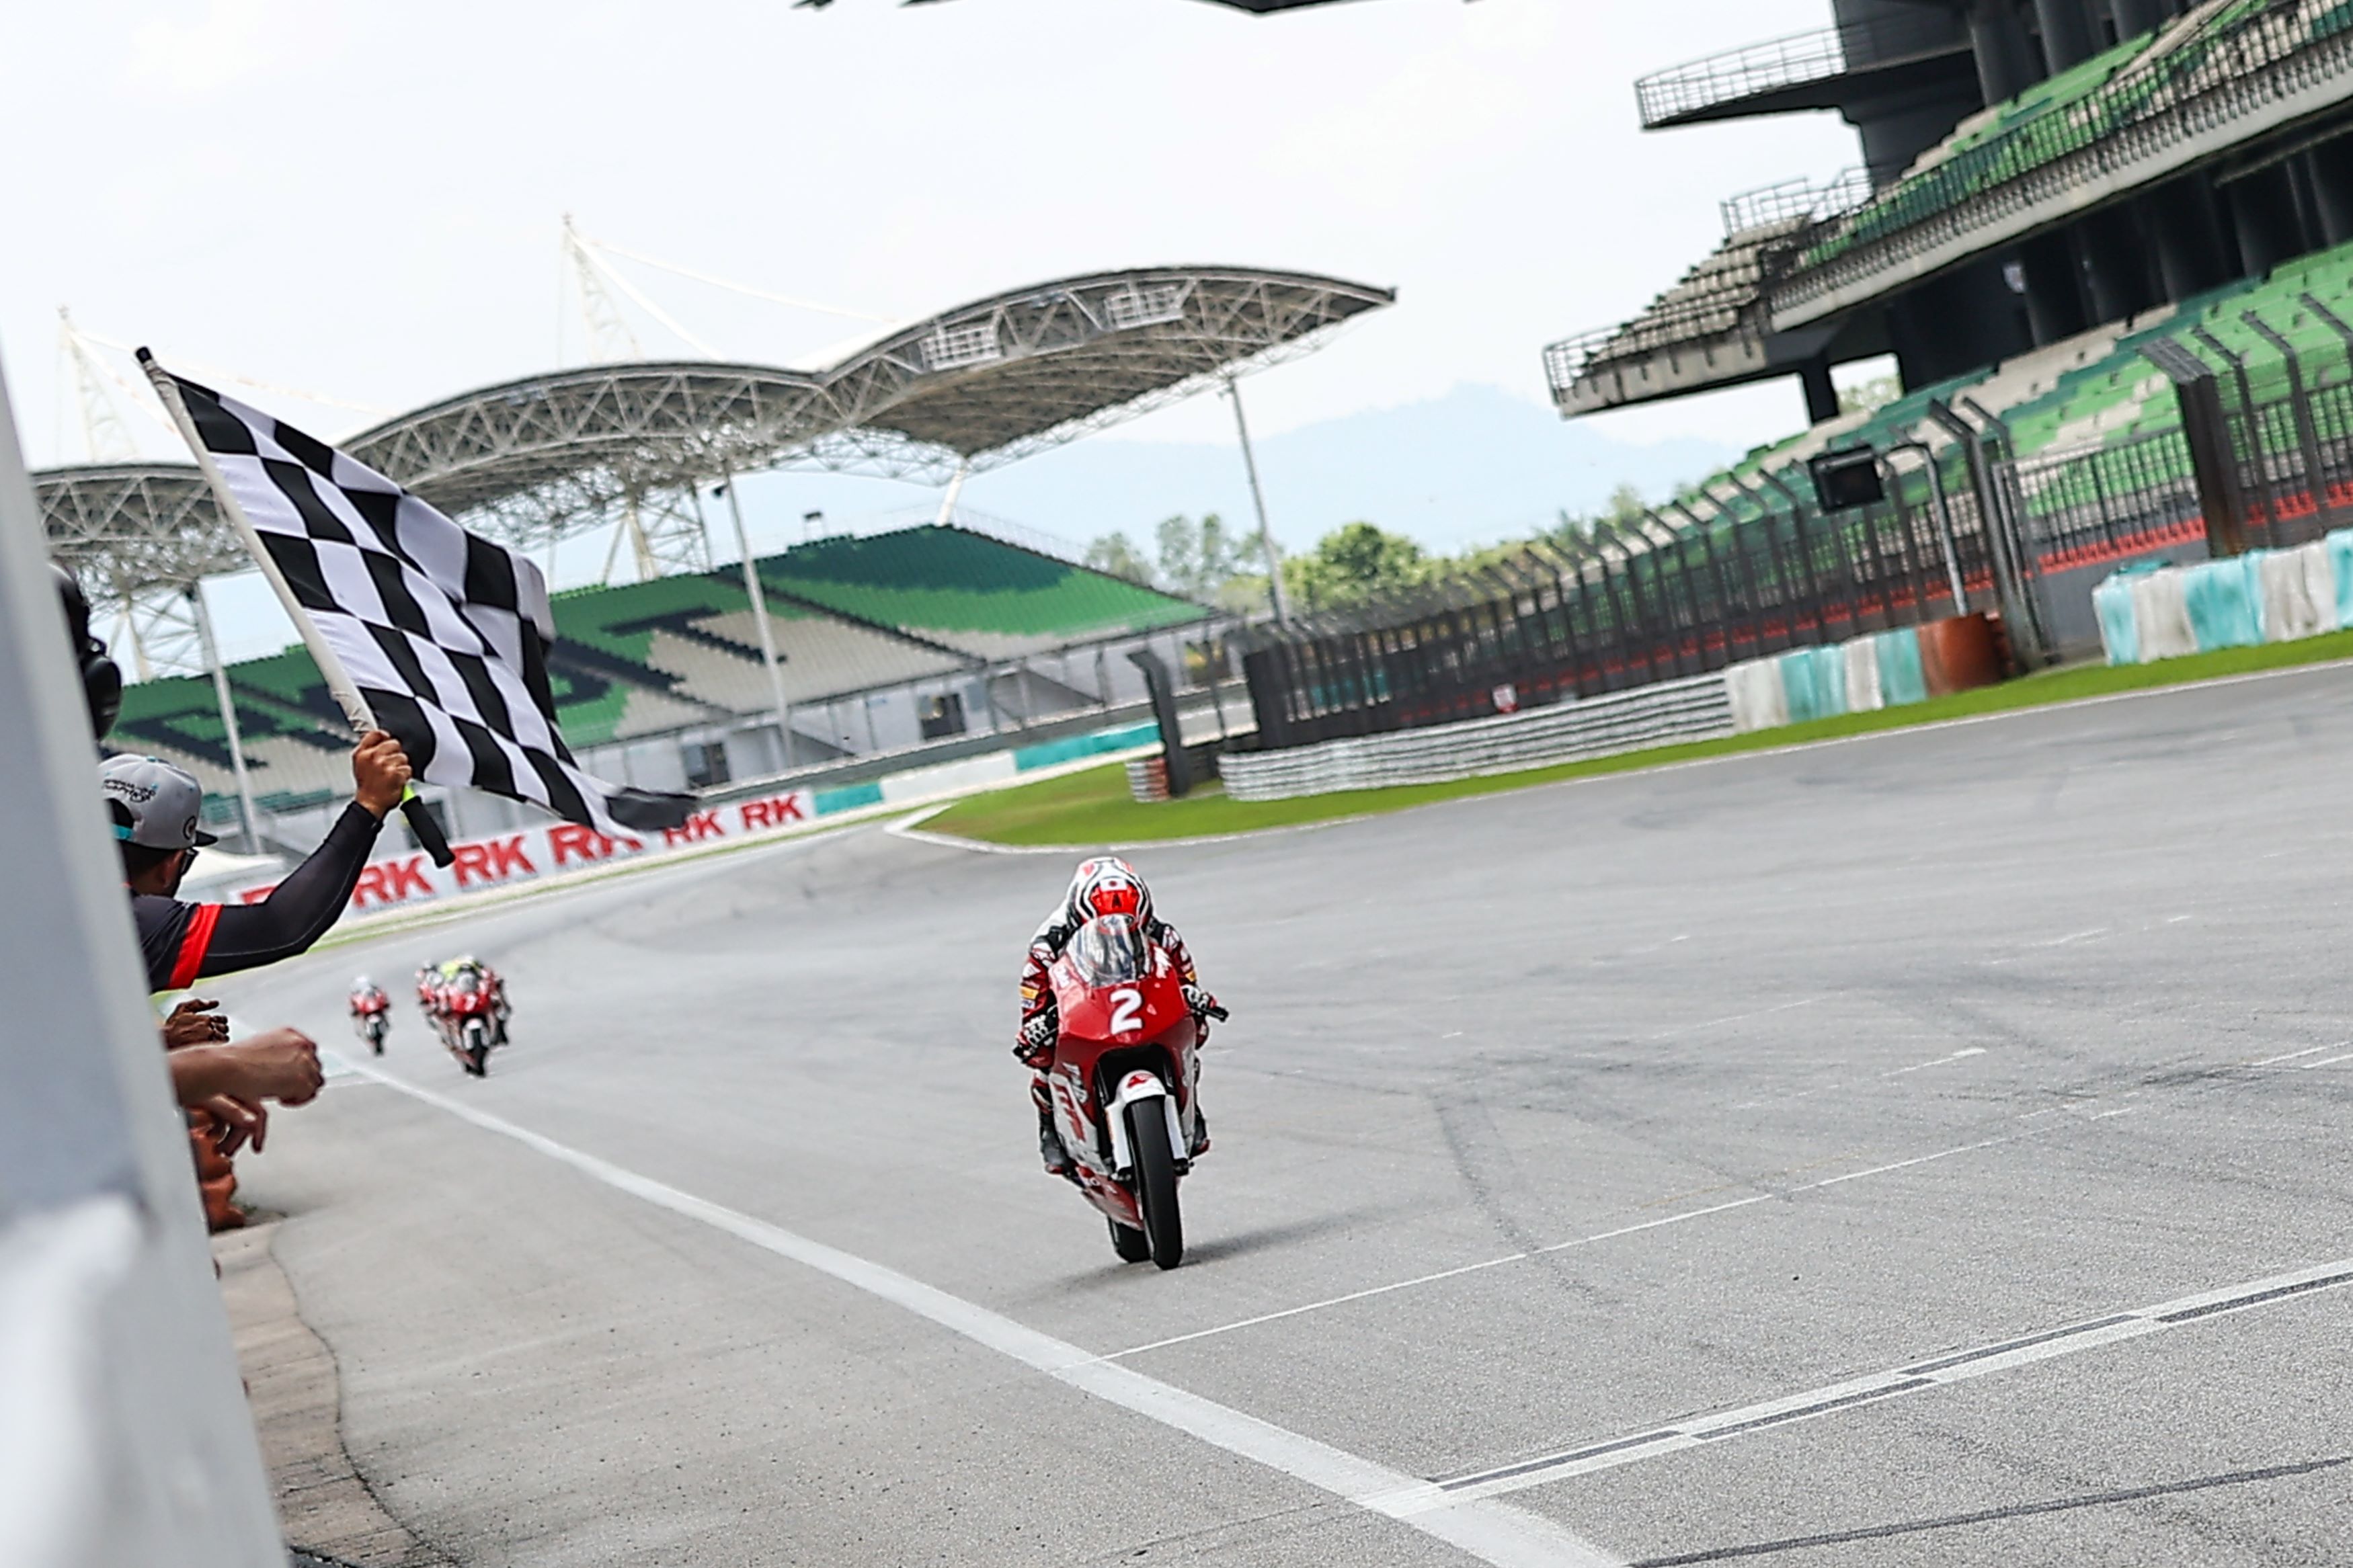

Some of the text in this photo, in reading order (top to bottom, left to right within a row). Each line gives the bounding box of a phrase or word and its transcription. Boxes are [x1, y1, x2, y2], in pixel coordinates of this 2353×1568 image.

[352, 855, 433, 907] RK
[451, 835, 536, 887] RK
[740, 792, 803, 830] RK
[1111, 988, 1142, 1035] 2
